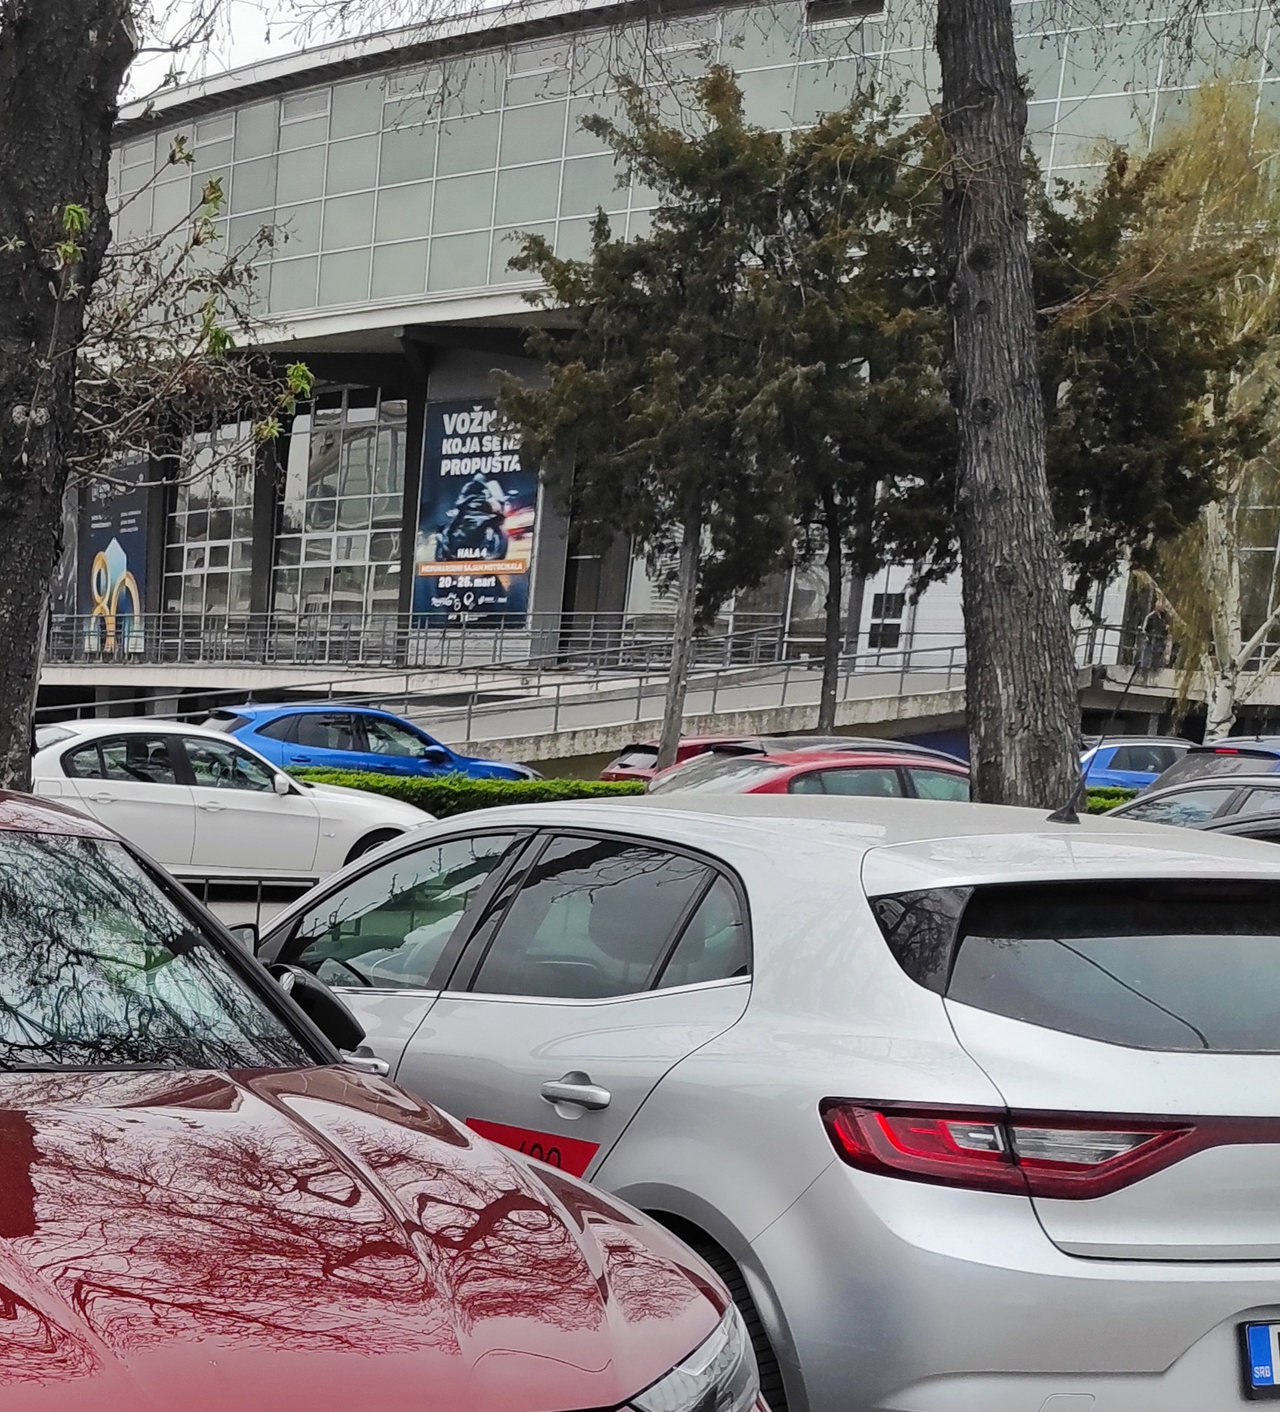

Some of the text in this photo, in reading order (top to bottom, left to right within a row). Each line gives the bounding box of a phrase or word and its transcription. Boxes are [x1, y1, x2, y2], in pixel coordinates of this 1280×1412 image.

[441, 436, 480, 455] KOJA
[481, 434, 501, 452] SE
[440, 451, 522, 476] PROPUŠTA
[1253, 1365, 1271, 1379] SRB
